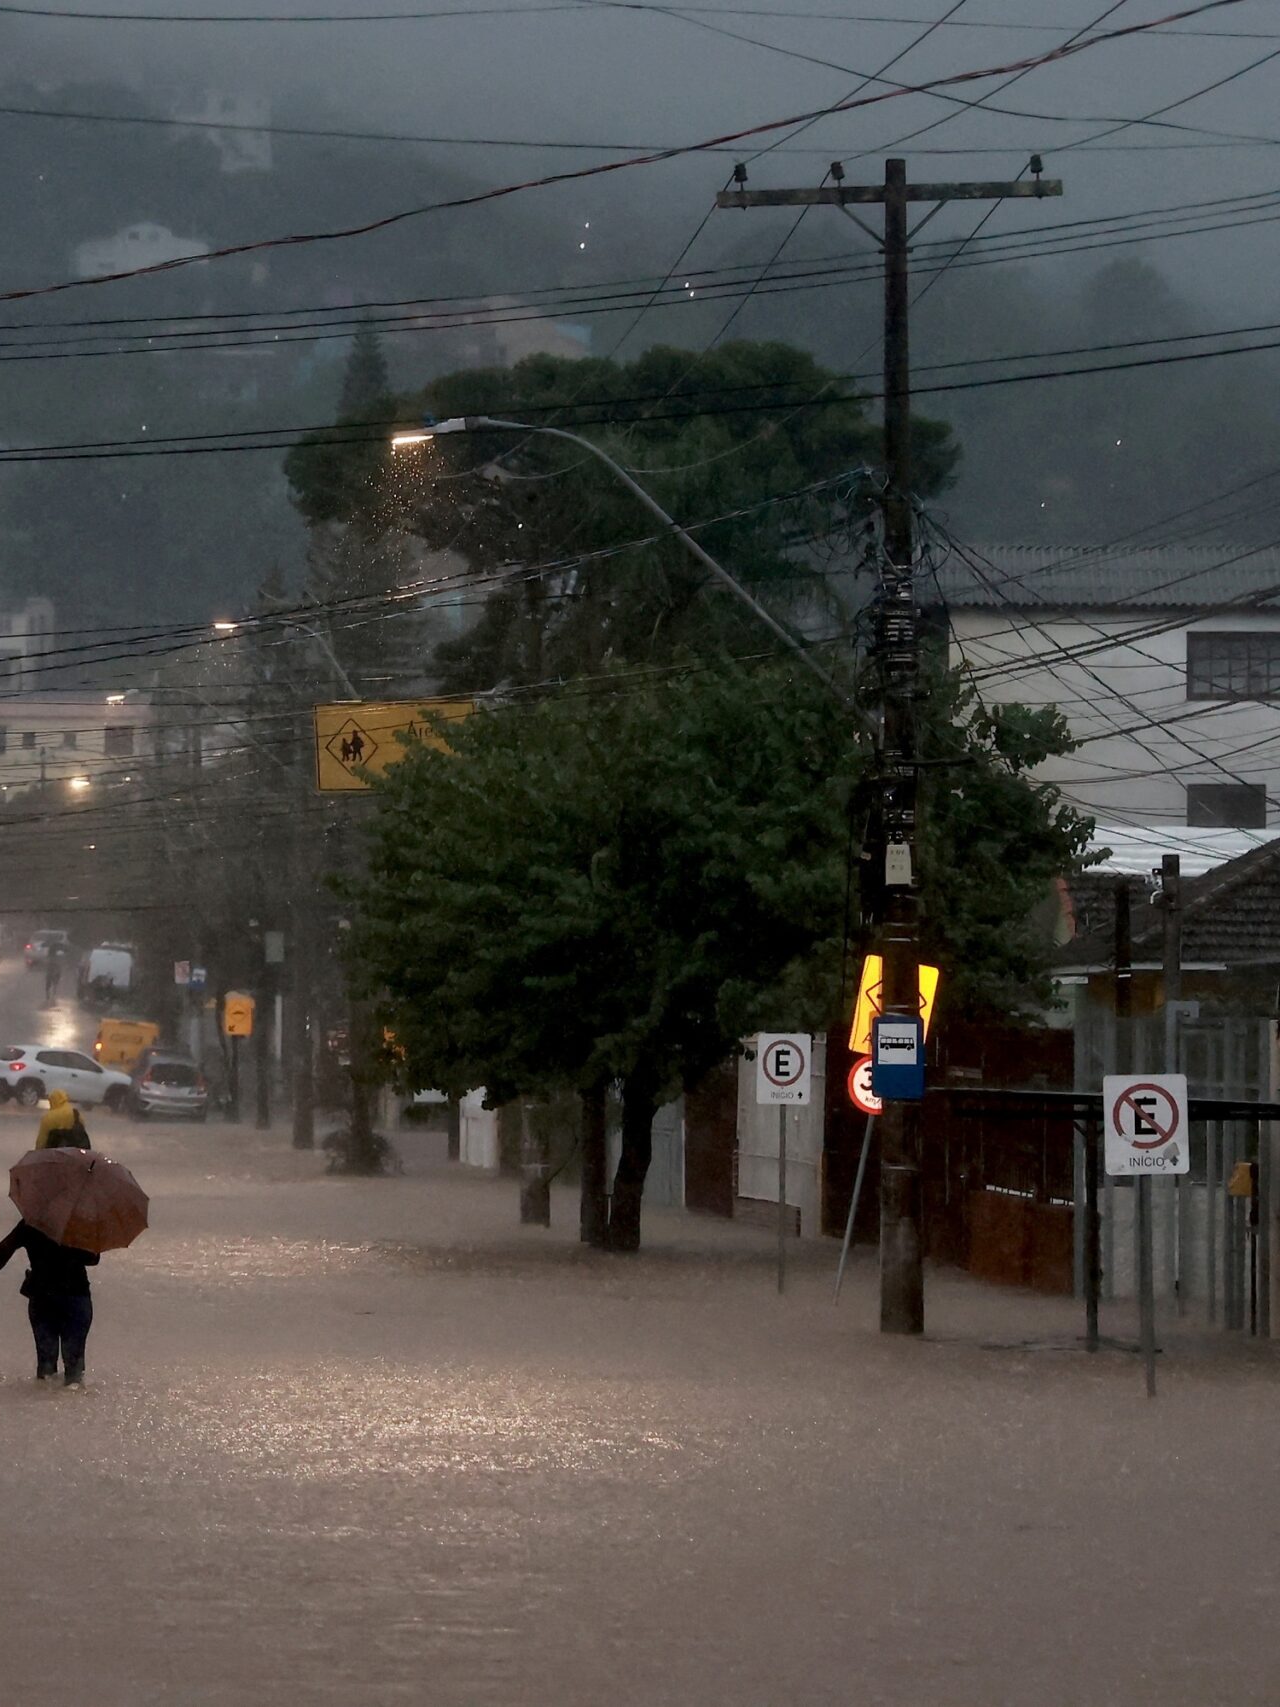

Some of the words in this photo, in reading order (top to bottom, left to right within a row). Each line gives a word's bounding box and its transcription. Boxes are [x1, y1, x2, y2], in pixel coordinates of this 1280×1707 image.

[775, 1049, 790, 1076] E
[865, 1096, 880, 1105] km/
[1134, 1097, 1157, 1135] E
[1129, 1155, 1165, 1167] INÍCIO
